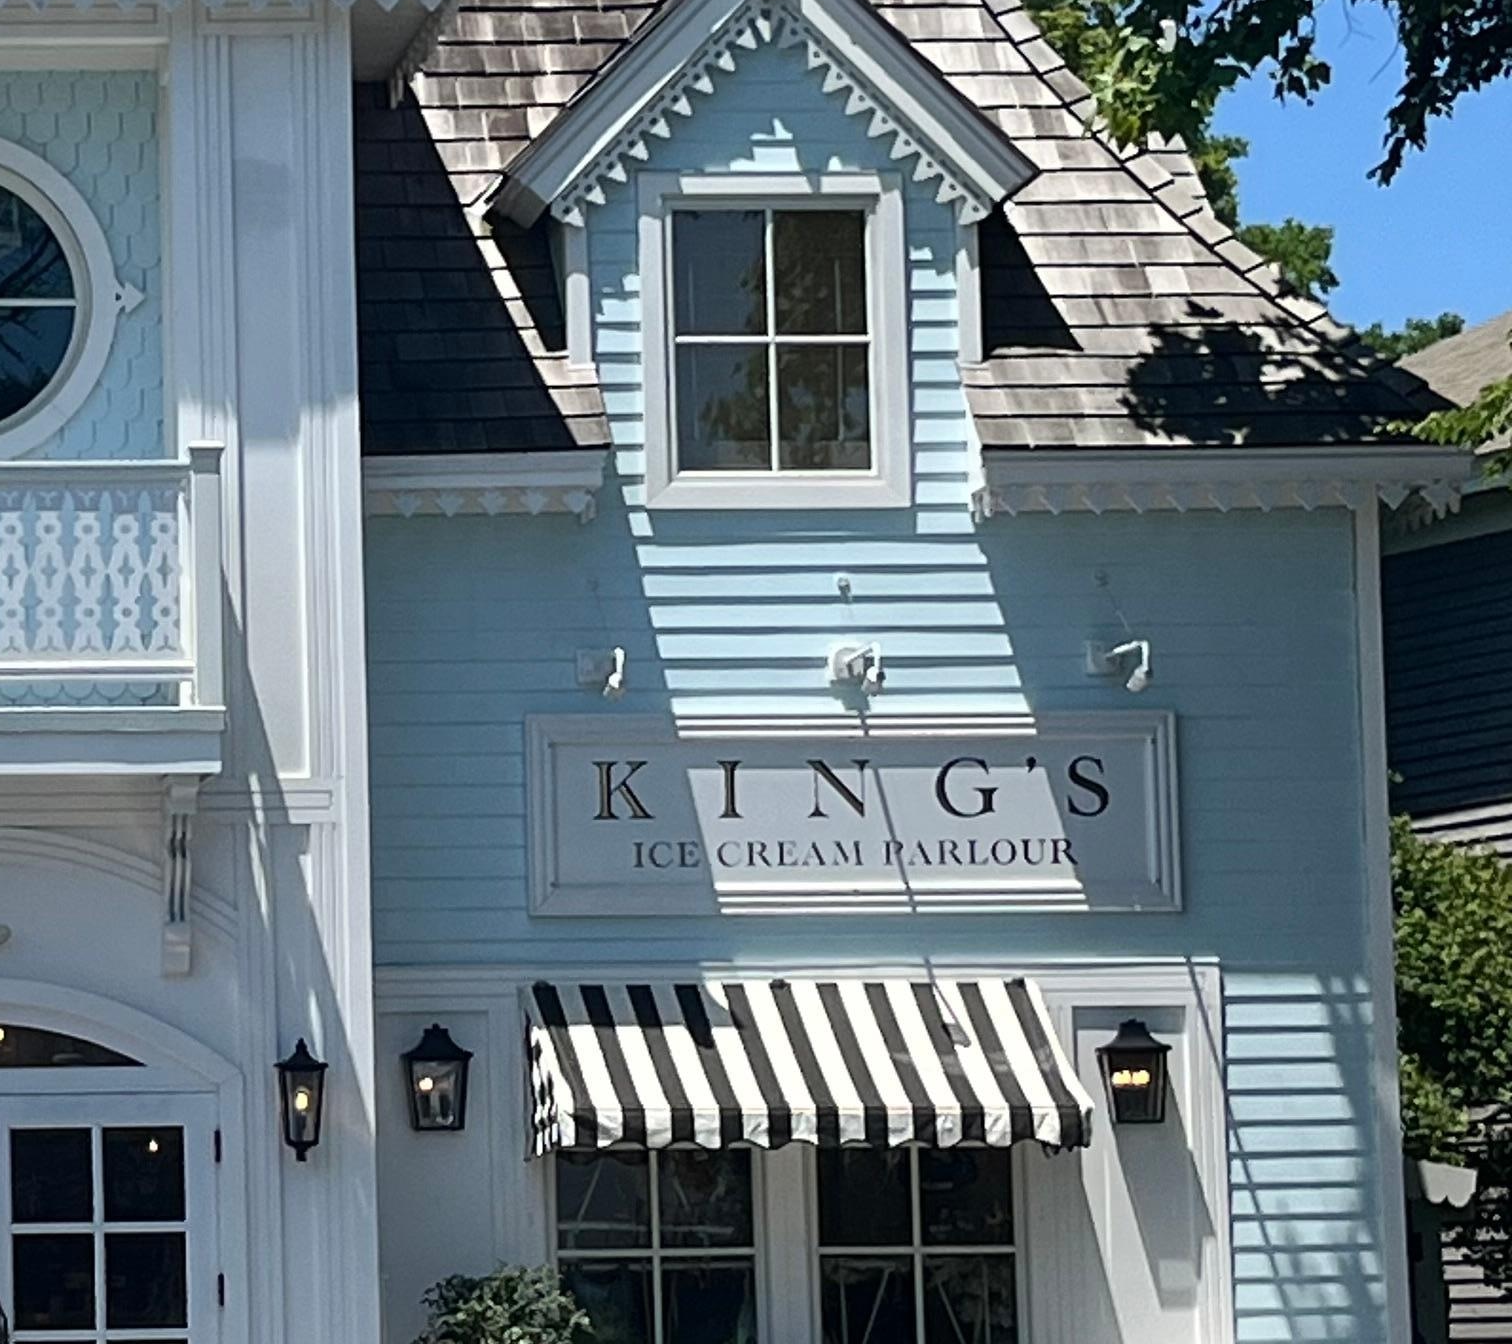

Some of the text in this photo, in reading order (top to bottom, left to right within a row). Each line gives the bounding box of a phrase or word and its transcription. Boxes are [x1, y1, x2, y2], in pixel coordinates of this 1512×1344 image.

[592, 756, 1110, 820] KING'S
[633, 838, 1079, 869] ICE CREAM PARLOUR
